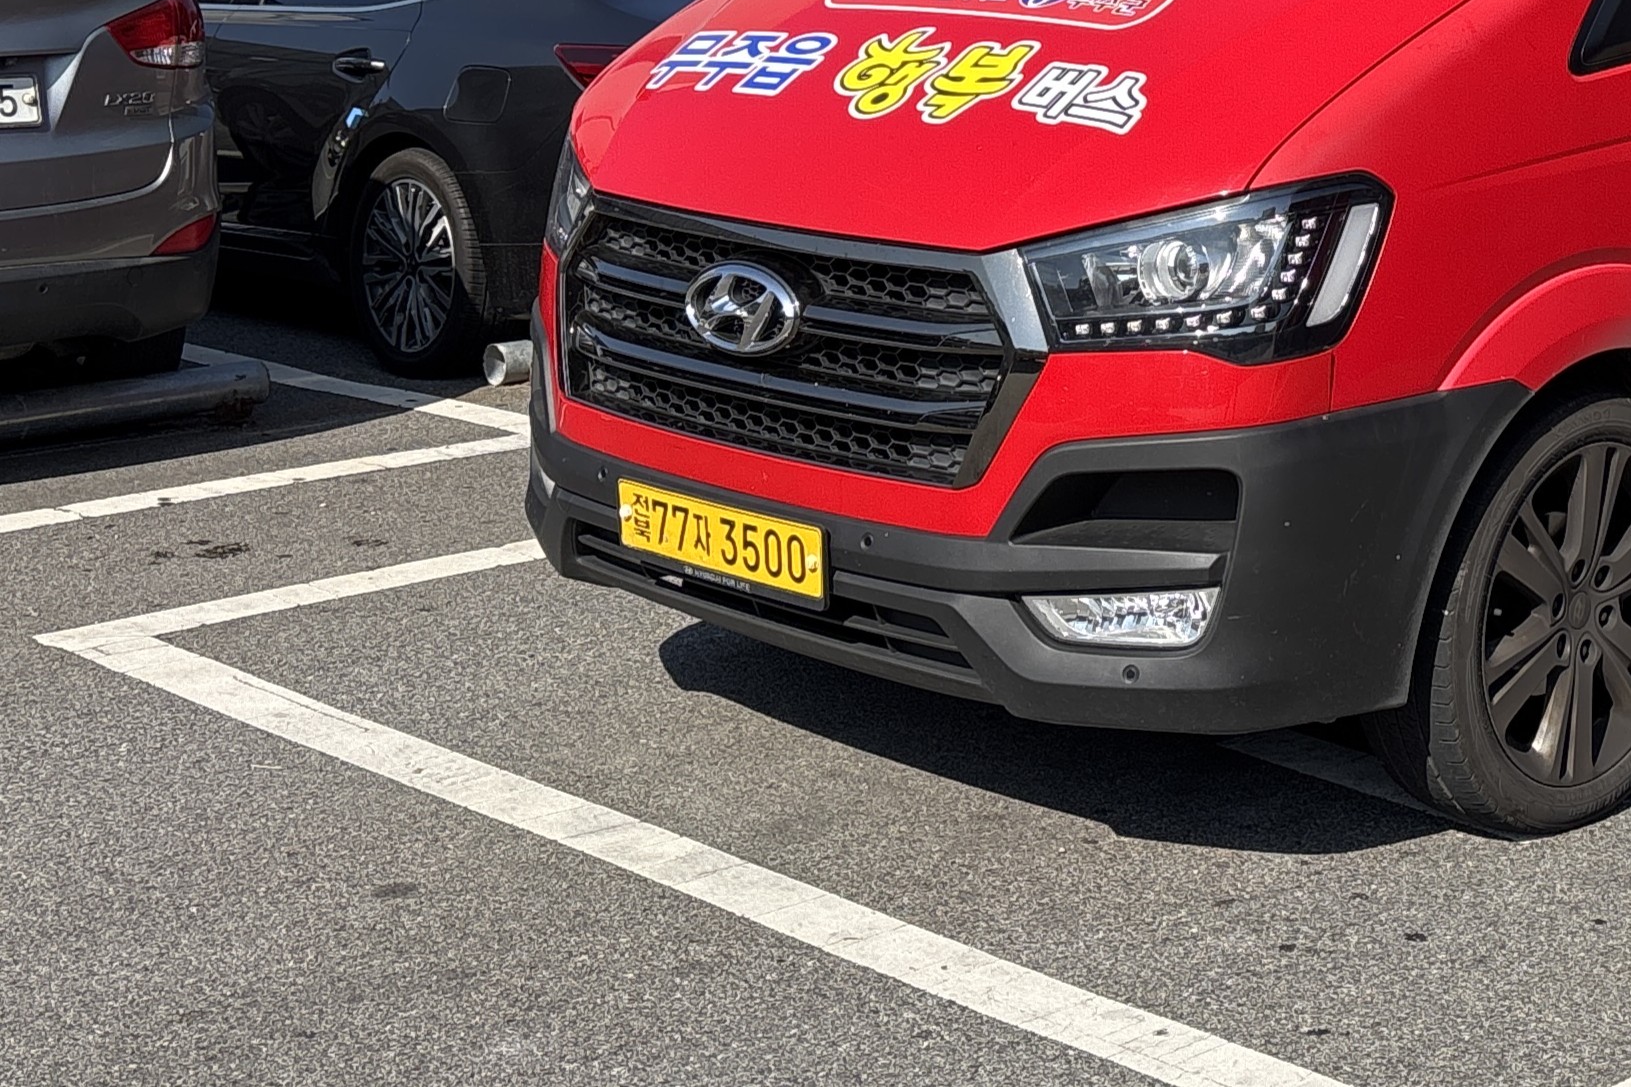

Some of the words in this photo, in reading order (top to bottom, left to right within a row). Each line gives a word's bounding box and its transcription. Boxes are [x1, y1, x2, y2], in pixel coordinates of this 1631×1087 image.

[648, 31, 837, 95] 무주읍
[632, 491, 651, 544] 전북
[651, 500, 712, 557] 77자
[719, 518, 807, 584] 3500
